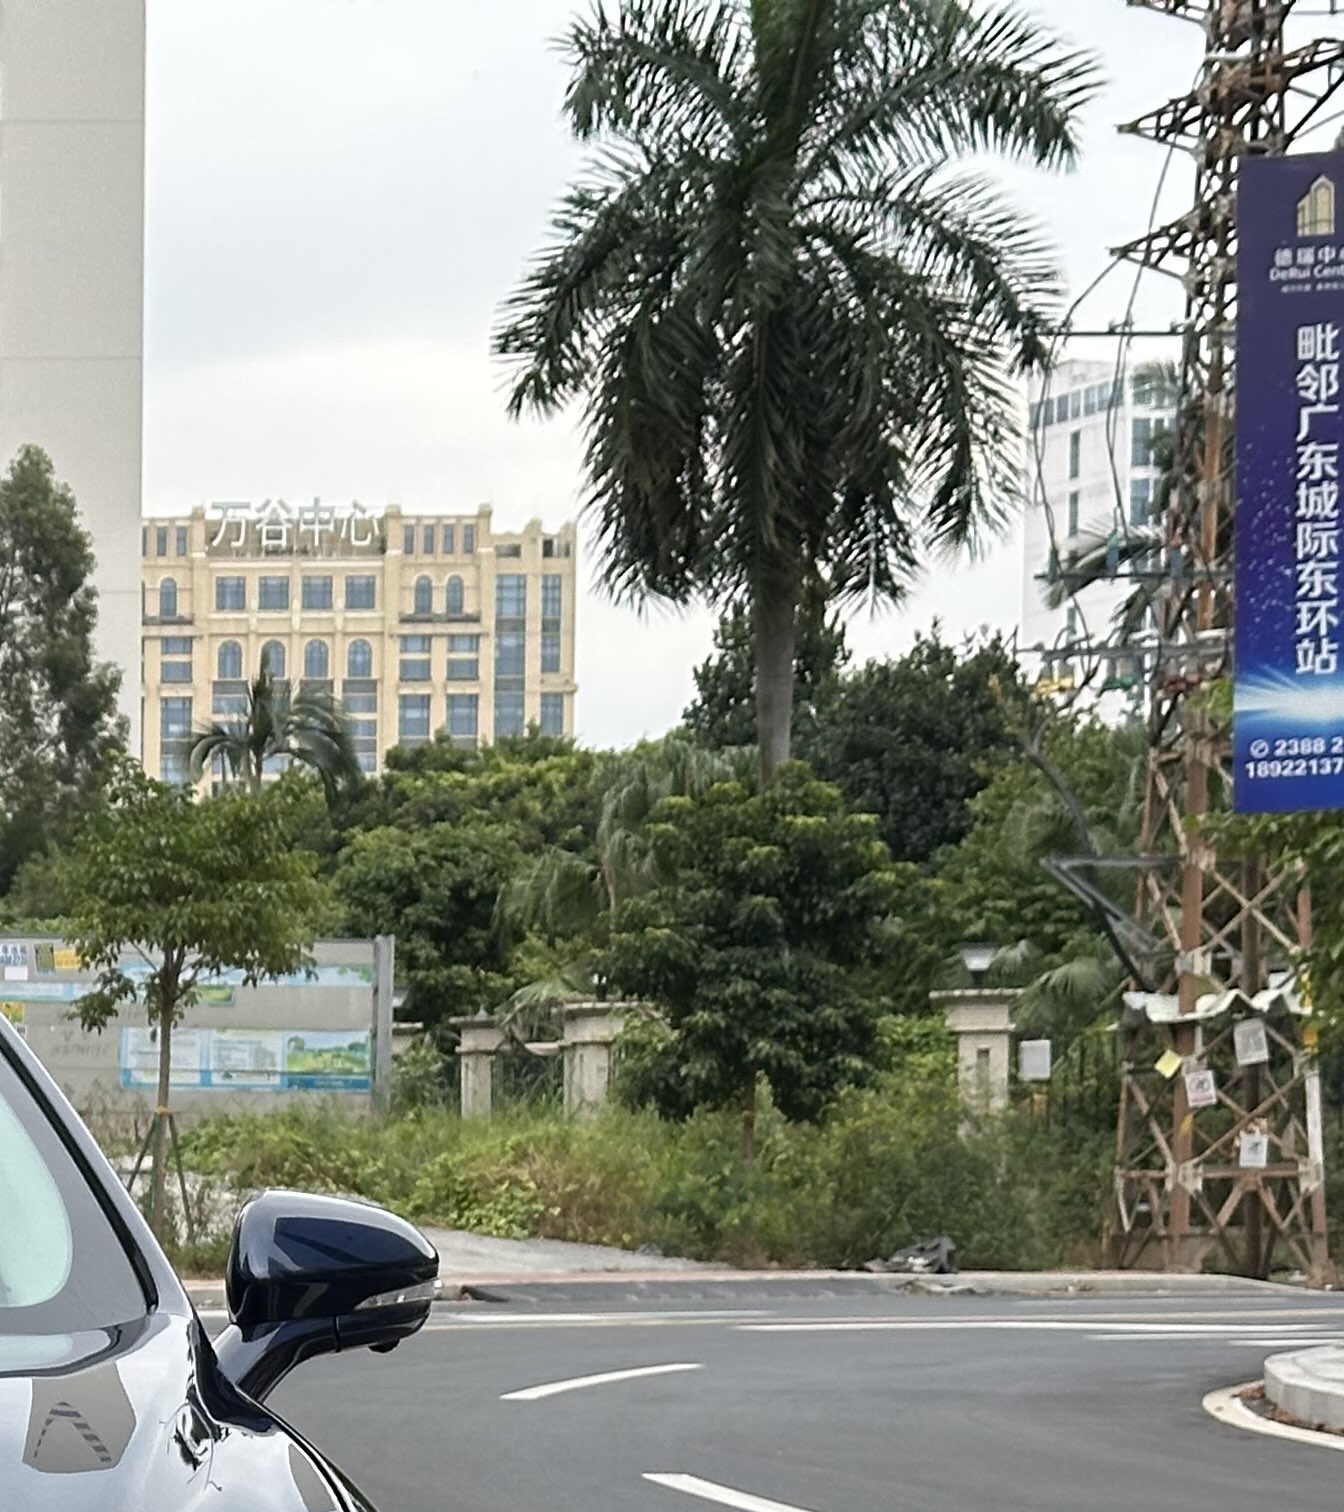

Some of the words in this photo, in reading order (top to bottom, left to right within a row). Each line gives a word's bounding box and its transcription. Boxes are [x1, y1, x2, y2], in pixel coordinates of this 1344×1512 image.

[210, 496, 380, 548] 万谷中心
[1295, 322, 1341, 675] 毗邻广东城际东环站
[1273, 737, 1326, 757] 2388
